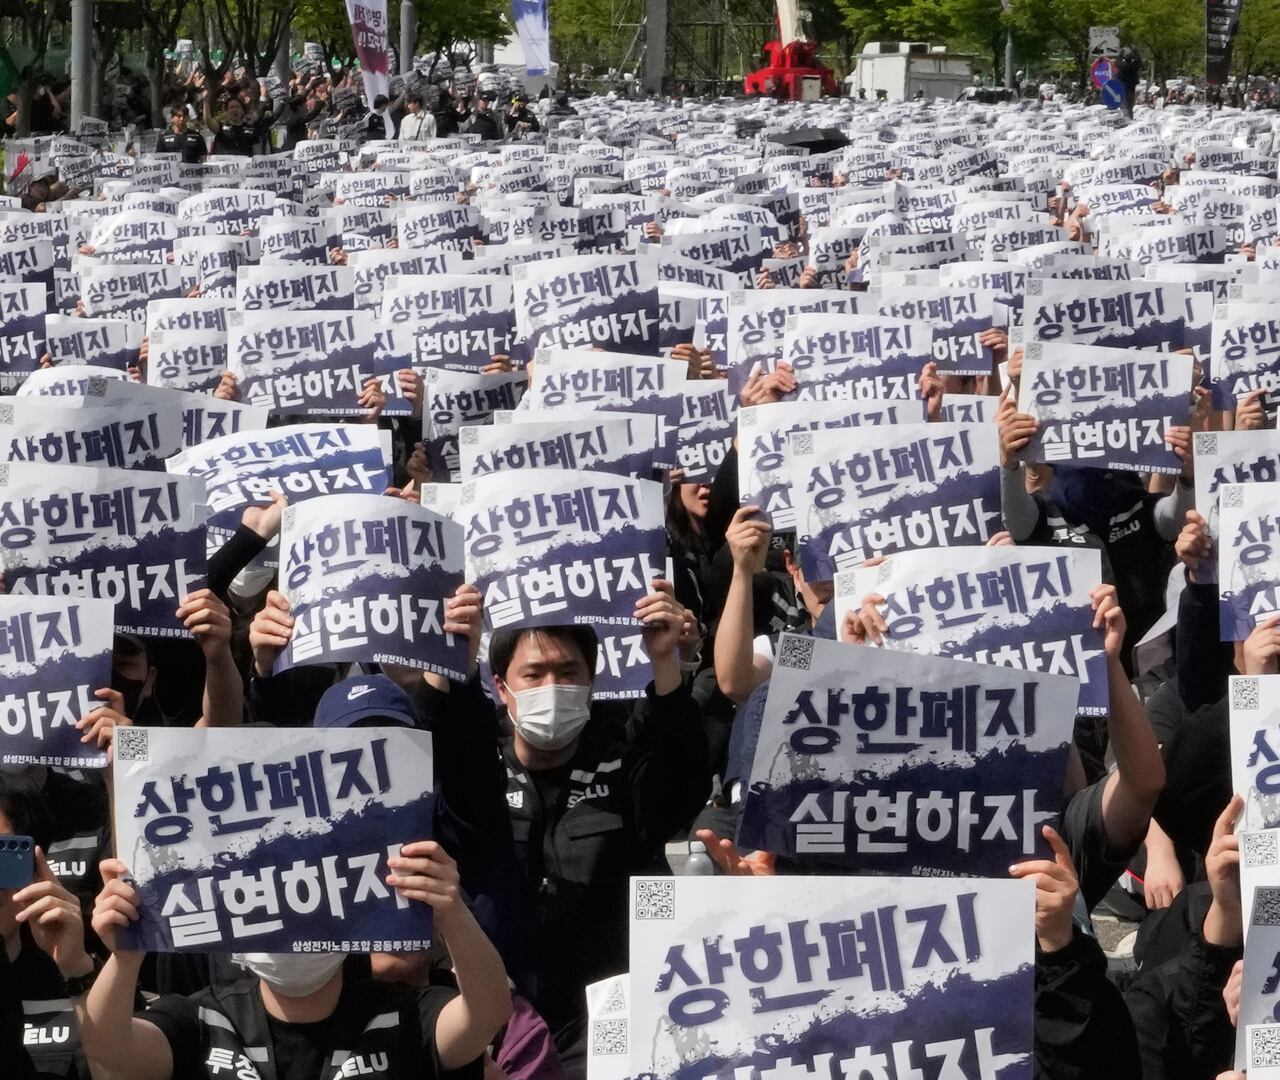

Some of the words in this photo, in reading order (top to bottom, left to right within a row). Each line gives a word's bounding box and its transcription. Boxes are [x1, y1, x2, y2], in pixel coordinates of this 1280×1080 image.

[402, 206, 472, 238] 상한폐지
[990, 229, 1060, 252] 상한폐지
[1136, 229, 1215, 262] 상한폐지
[87, 270, 168, 305] 상한폐지
[241, 270, 339, 310] 상한폐지
[389, 284, 492, 324] 상한폐지
[522, 263, 642, 317] 상한폐지
[237, 316, 356, 354] 상한폐지
[1032, 291, 1164, 340] 상한폐지
[789, 325, 913, 370] 상한폐지
[246, 363, 377, 408] 실현하자
[1031, 359, 1170, 408] 상한폐지
[189, 427, 353, 479] 상한폐지
[1042, 414, 1175, 463] 실현하자
[809, 429, 974, 509] 상한폐지
[467, 484, 645, 555] 상한폐지
[827, 497, 1003, 566] 실현하자
[285, 516, 446, 590] 상한폐지
[482, 552, 652, 629] 실현하자
[881, 556, 1071, 639] 상한폐지
[290, 595, 458, 662] 실현하자
[574, 615, 630, 626] 삼성전자노동조합
[372, 652, 430, 672] 삼성전자노동조합
[782, 683, 1040, 755] 상한폐지
[2, 754, 61, 767] 삼성전자노동조합
[134, 740, 388, 845] 상한폐지
[790, 789, 1060, 854] 실현하자
[44, 859, 84, 876] ELU
[161, 844, 412, 948] 실현하자
[292, 940, 370, 951] 삼성전자노동조합
[373, 940, 431, 951] 공동투쟁본부
[655, 892, 980, 1025] 상한폐지
[24, 1022, 70, 1044] ELU
